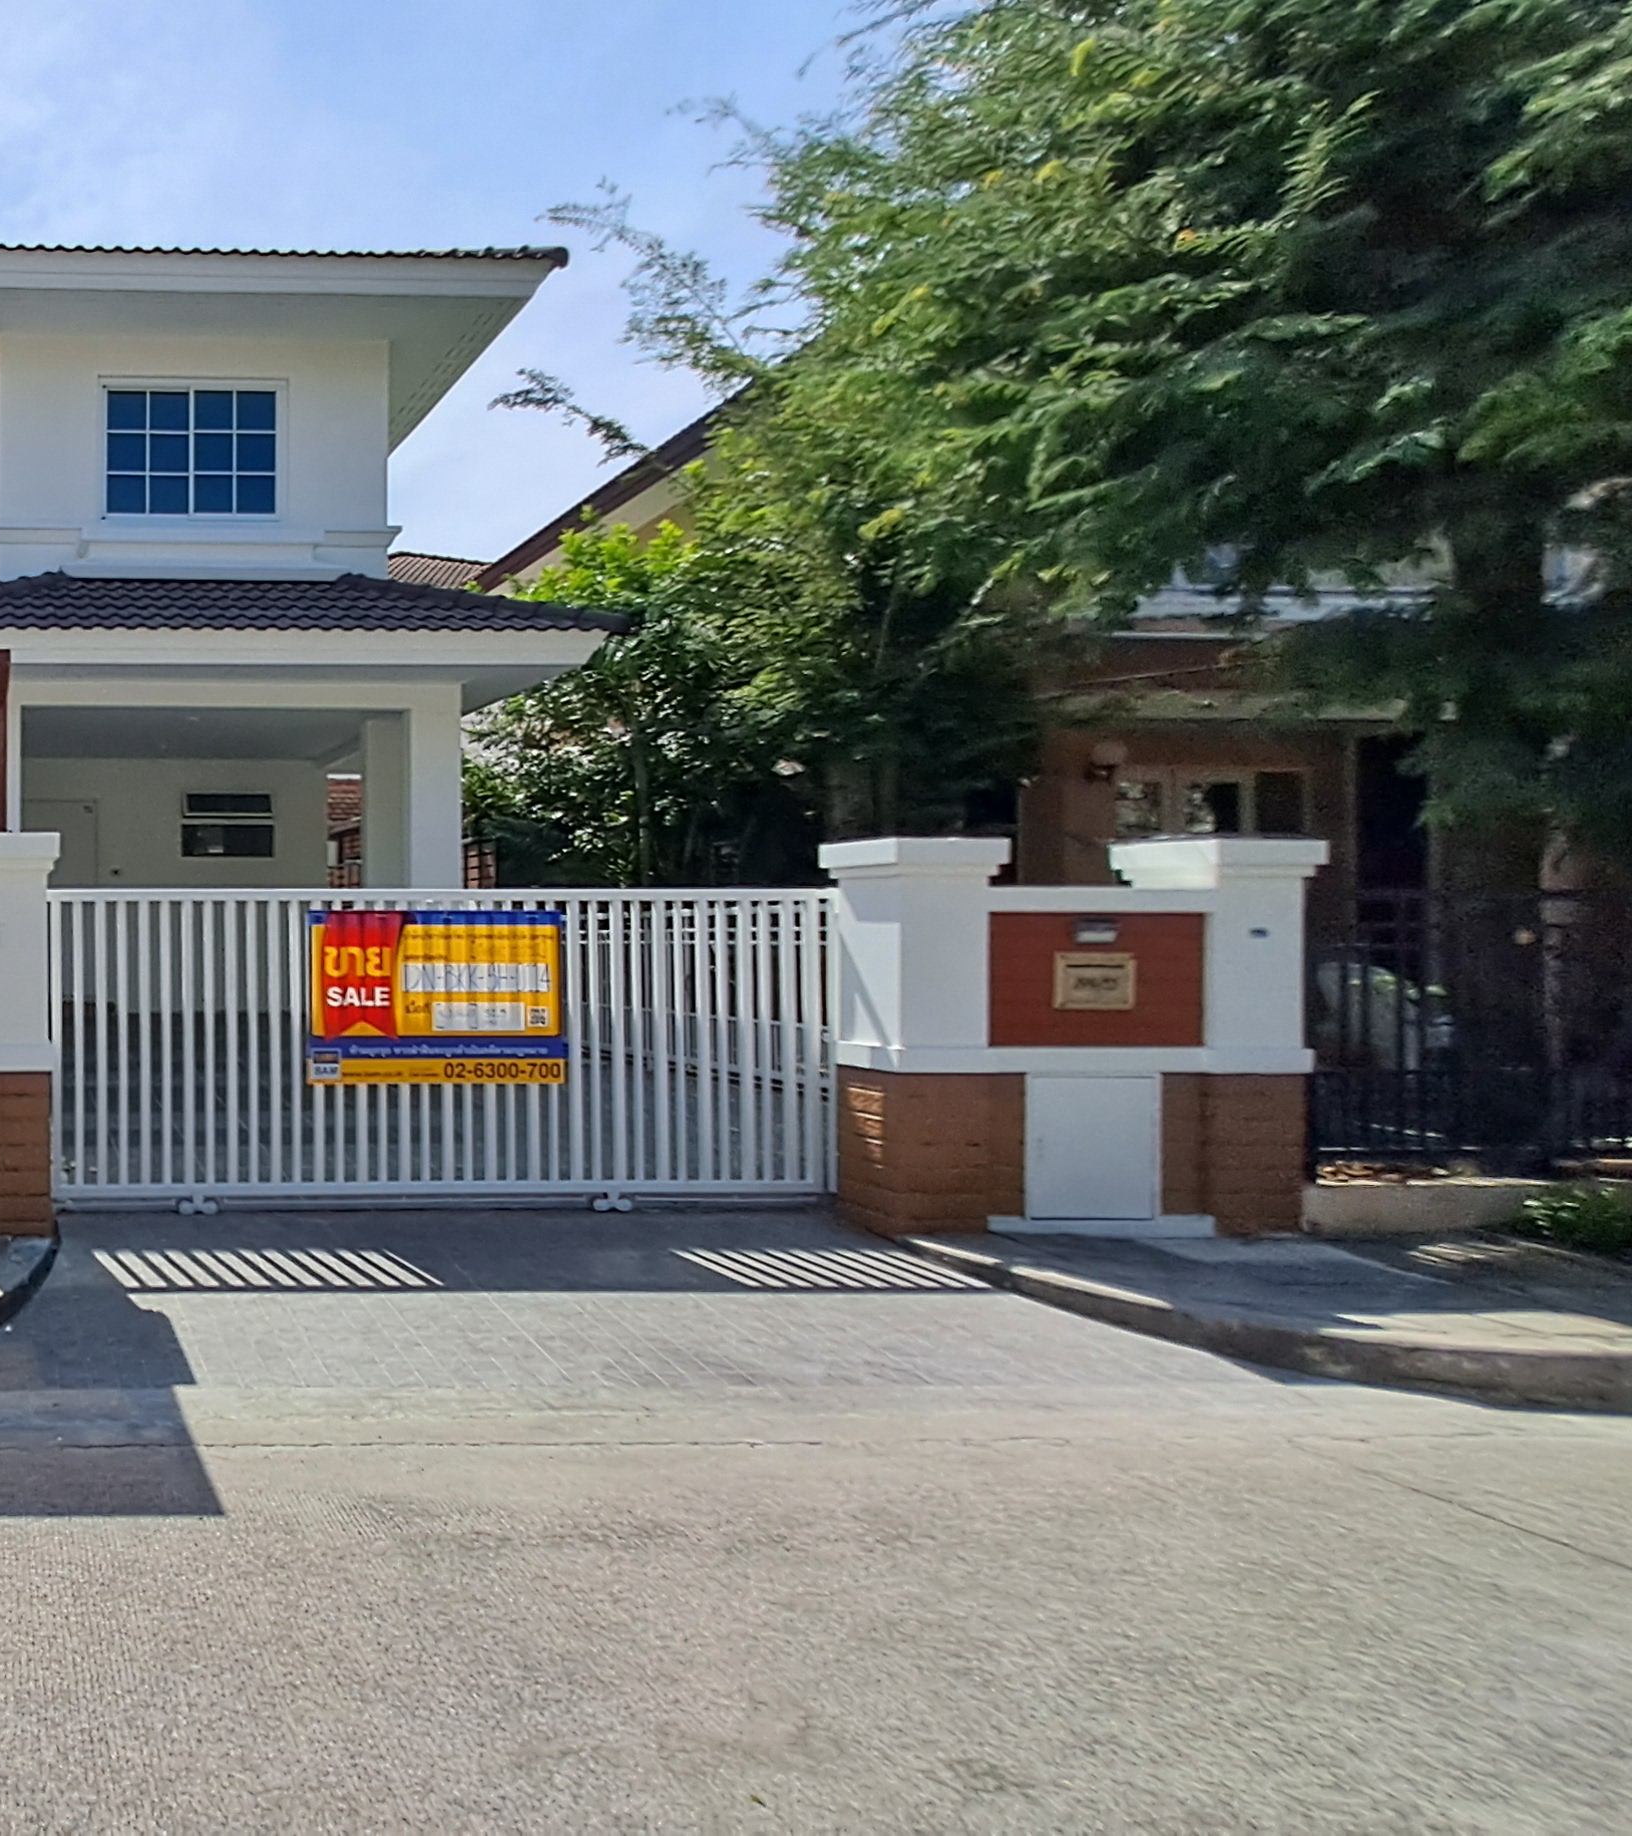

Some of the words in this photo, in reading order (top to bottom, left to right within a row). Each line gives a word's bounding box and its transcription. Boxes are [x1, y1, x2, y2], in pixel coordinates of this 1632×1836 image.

[324, 946, 391, 978] ขาย
[326, 986, 391, 1008] SALE
[444, 1062, 561, 1079] 02-6300-700
